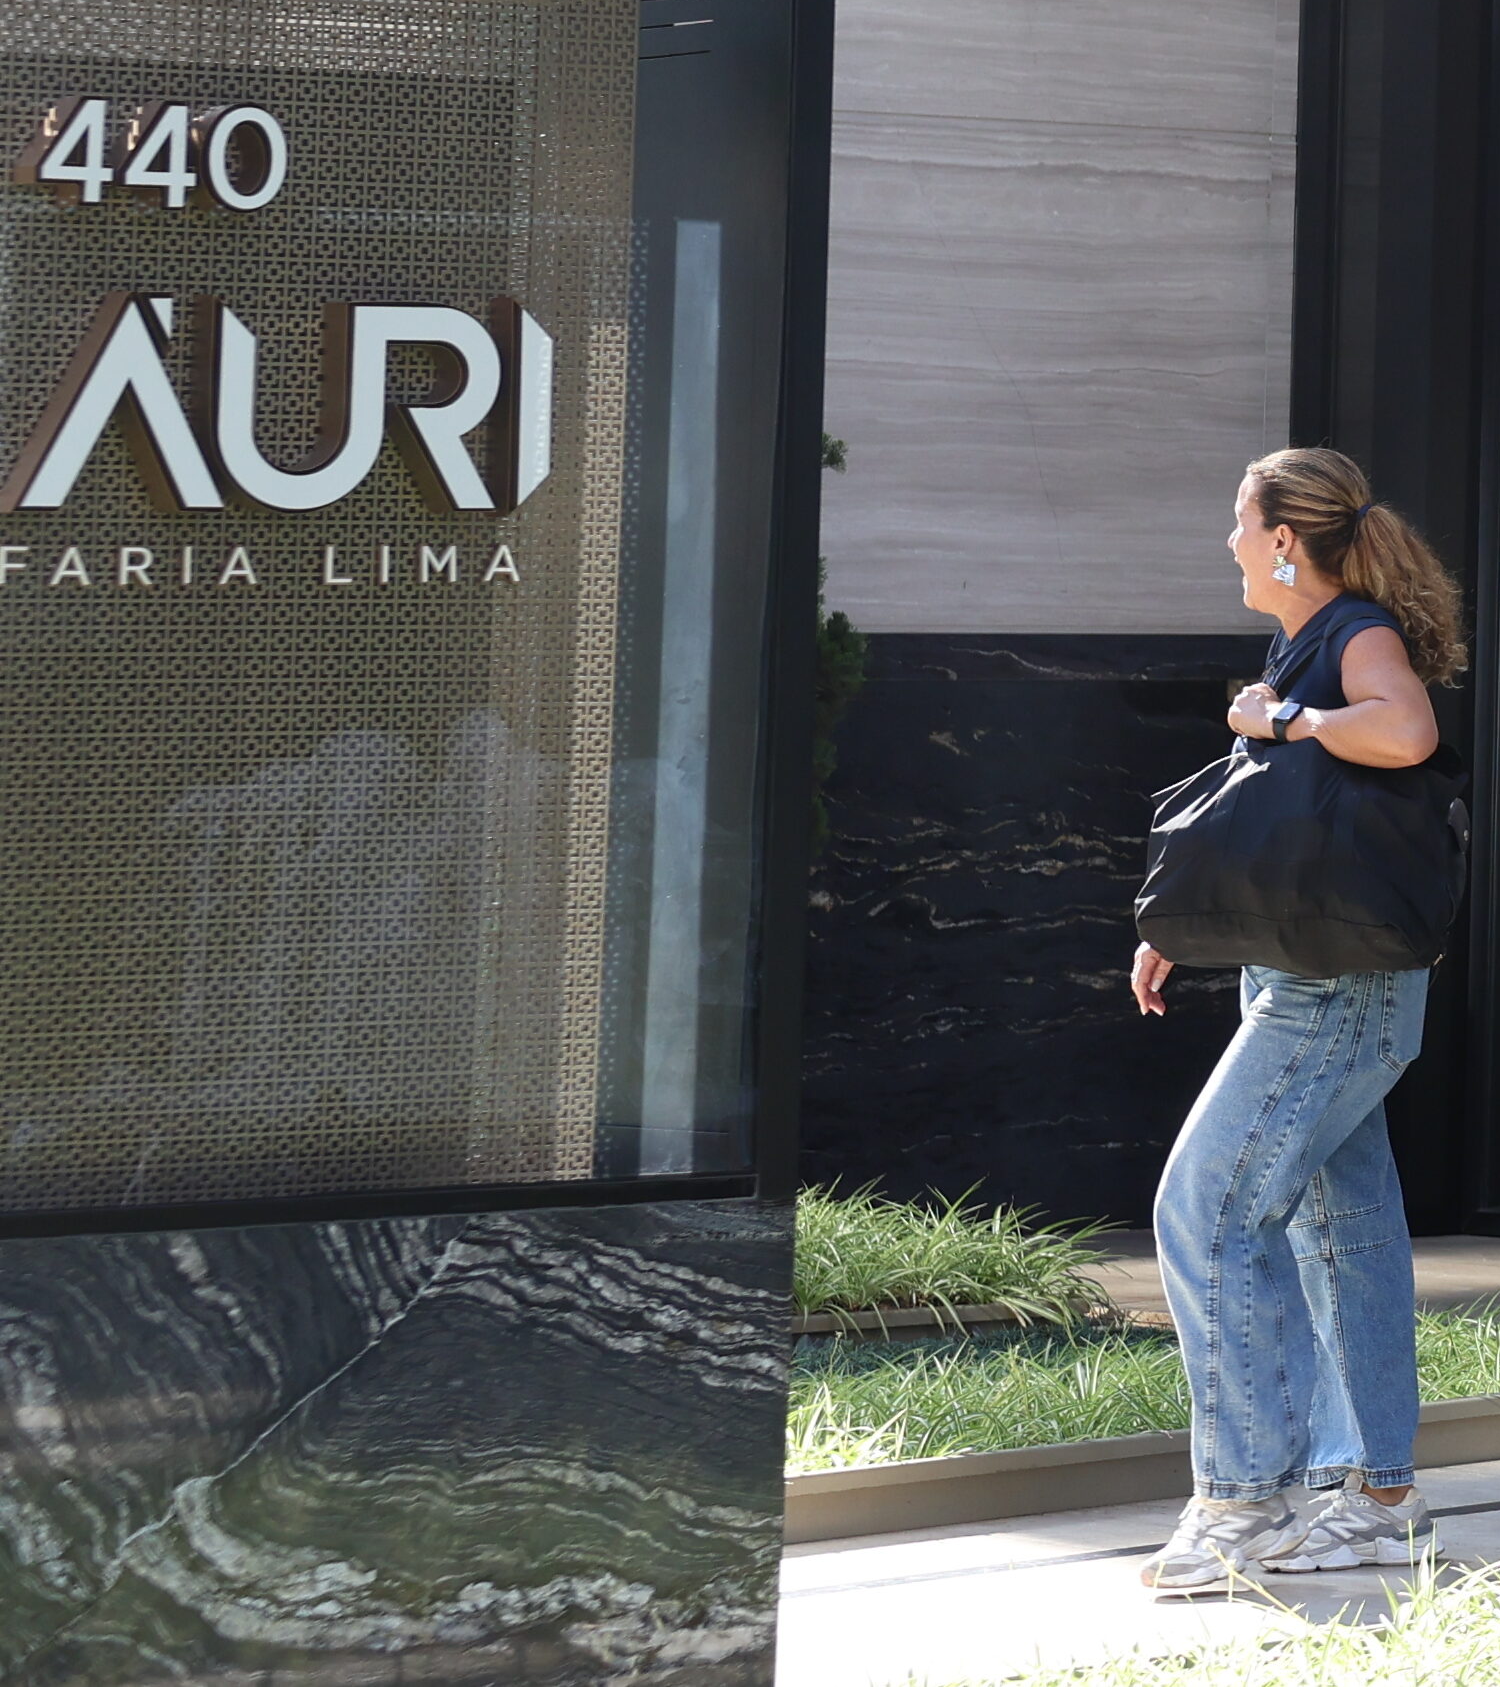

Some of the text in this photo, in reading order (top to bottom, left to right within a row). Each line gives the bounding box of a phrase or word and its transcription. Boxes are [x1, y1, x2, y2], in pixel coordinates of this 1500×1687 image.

[39, 98, 288, 211] 440
[0, 544, 521, 586] FARIA LIMA
